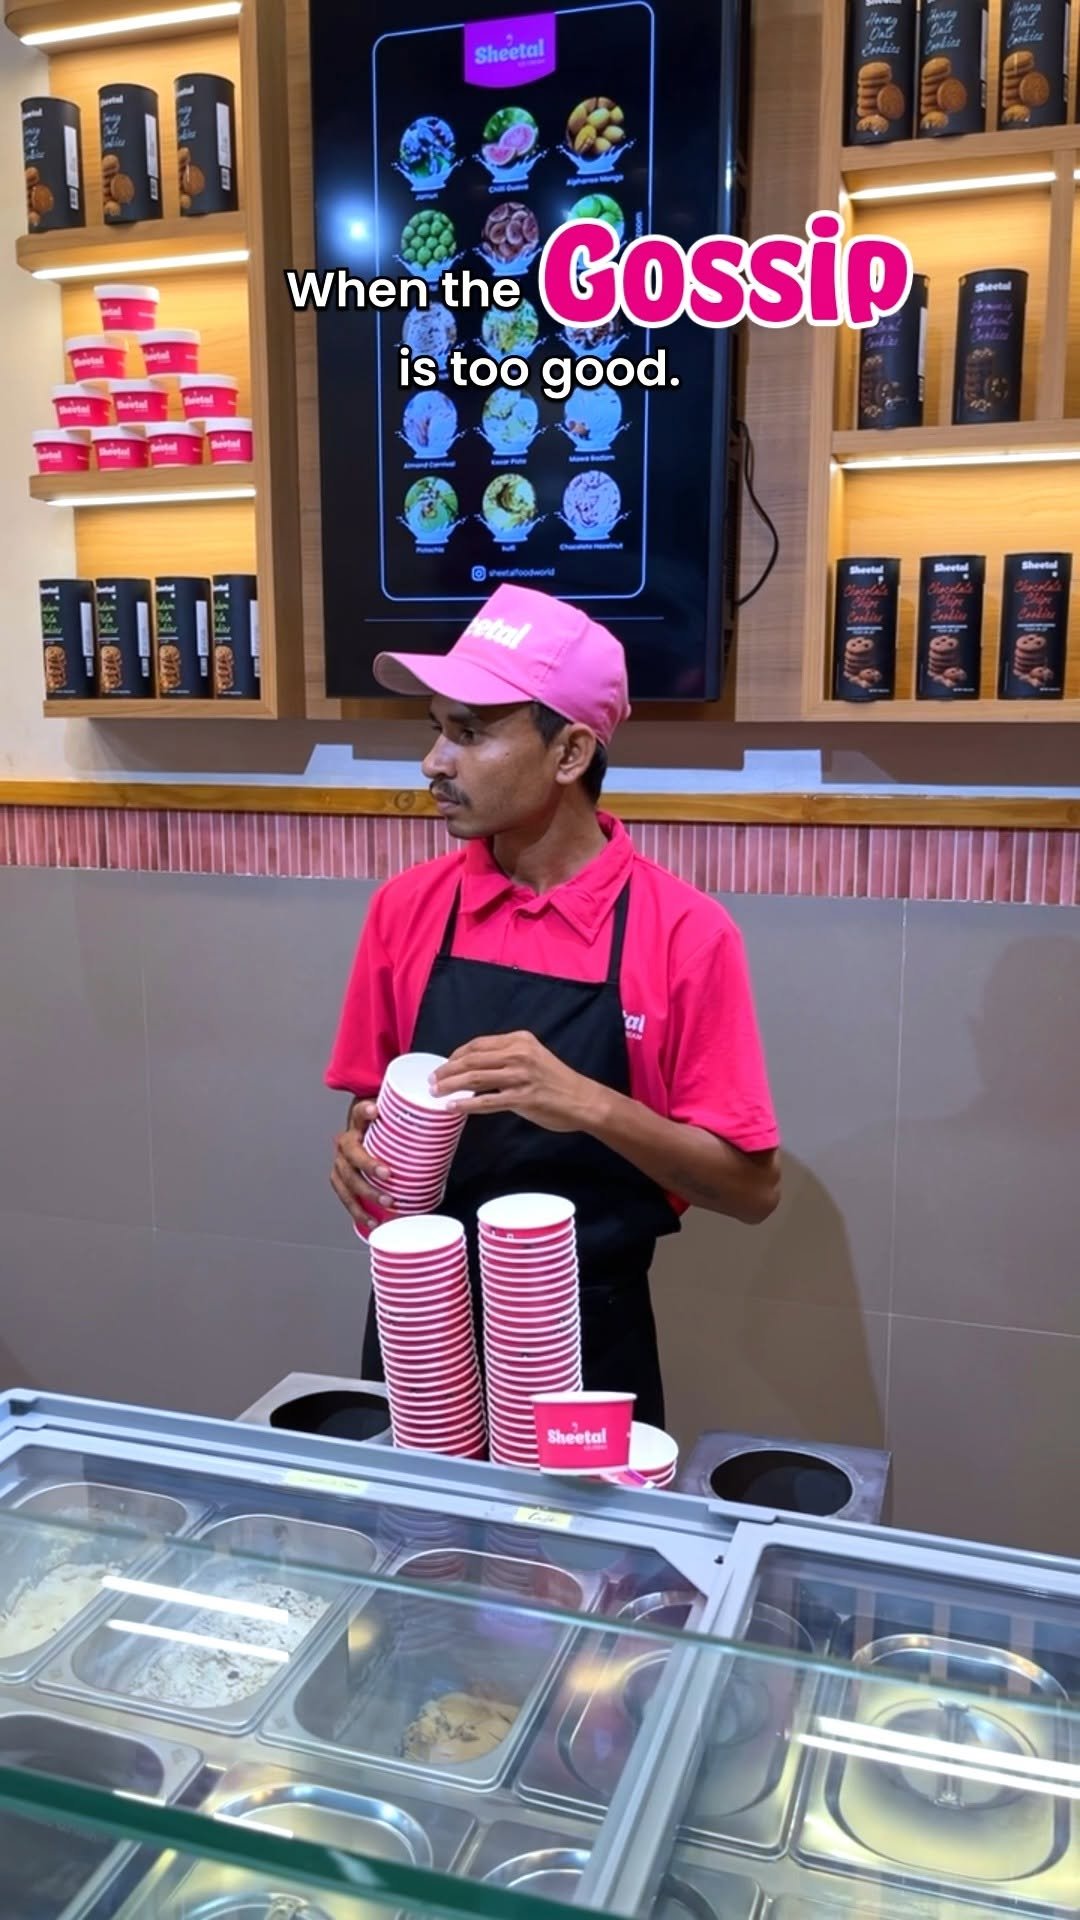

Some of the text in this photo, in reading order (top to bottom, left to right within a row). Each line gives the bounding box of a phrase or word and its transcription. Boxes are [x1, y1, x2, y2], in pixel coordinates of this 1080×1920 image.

[475, 38, 544, 65] Sheetal
[849, 565, 884, 575] Sheetal
[934, 562, 969, 573] Sheetal
[1022, 560, 1058, 570] Sheetal
[547, 1426, 607, 1445] Sheetal
